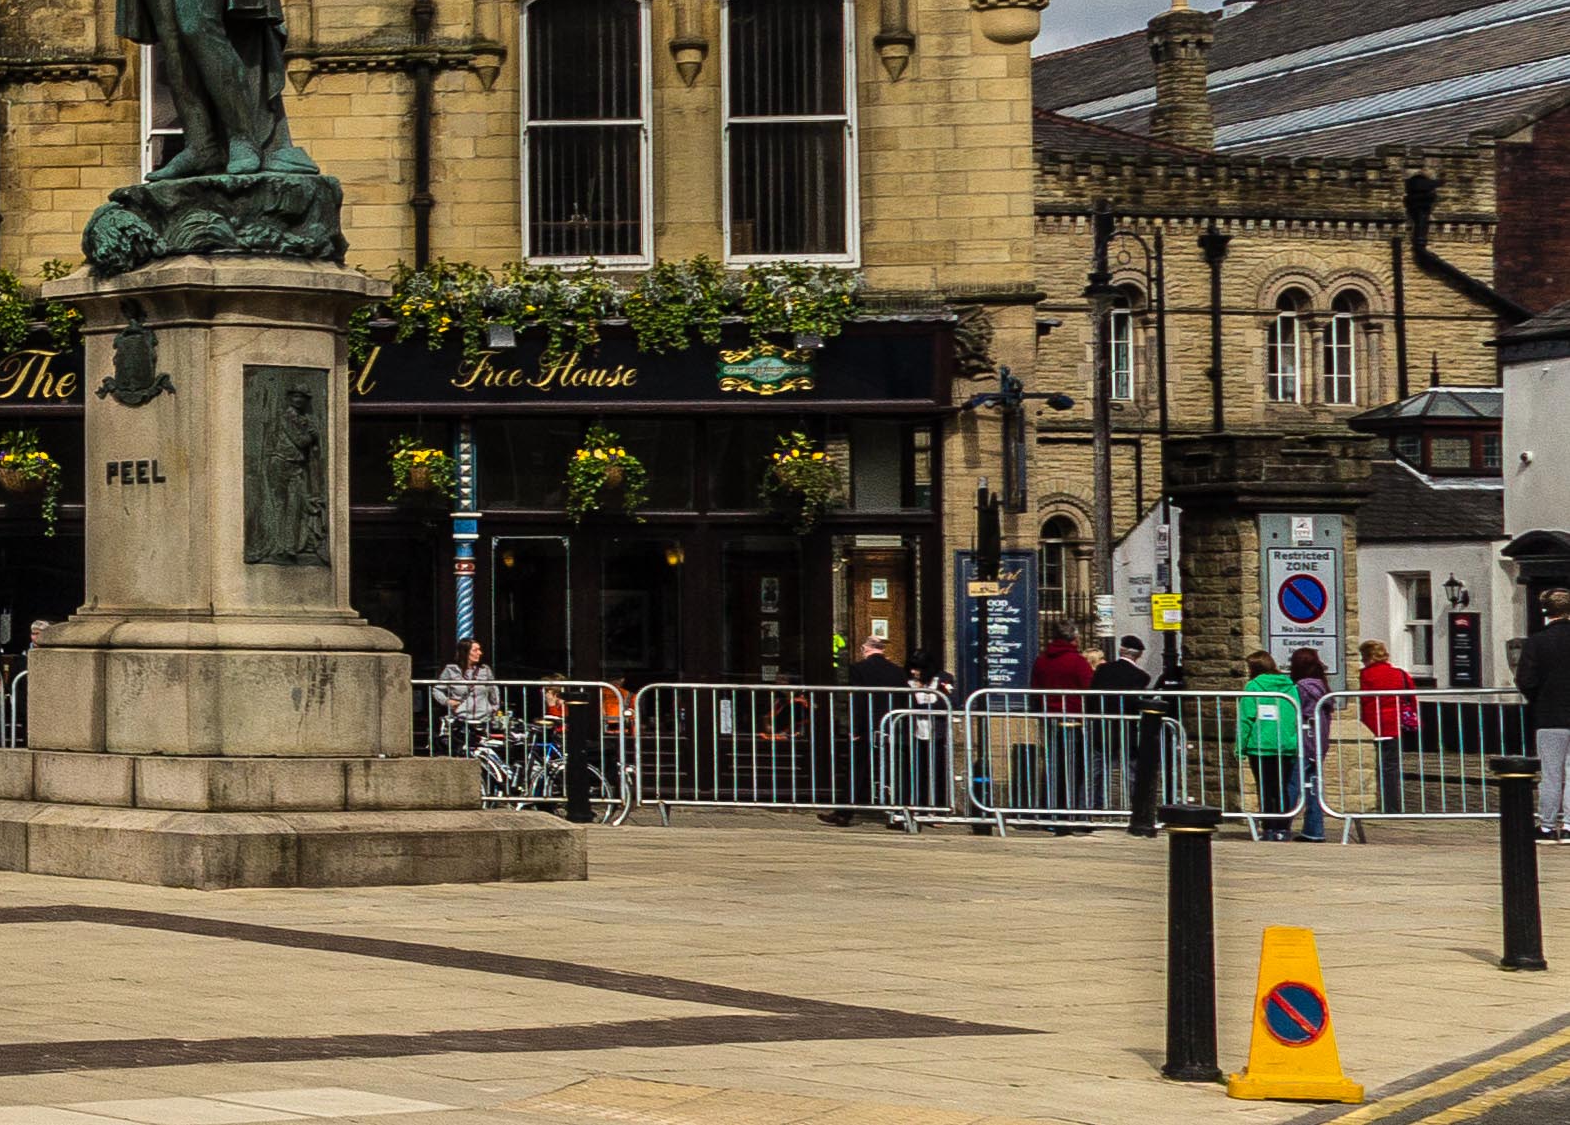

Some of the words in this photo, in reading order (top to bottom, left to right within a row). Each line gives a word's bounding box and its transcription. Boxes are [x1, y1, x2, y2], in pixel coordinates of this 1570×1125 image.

[450, 349, 523, 392] Free
[526, 350, 638, 392] House
[106, 459, 167, 486] PEEL
[1273, 550, 1330, 561] Restricted
[1285, 561, 1319, 572] ZONE
[1281, 625, 1294, 633] No
[1294, 625, 1326, 634] loading
[1282, 638, 1311, 647] Except
[1311, 638, 1325, 646] for
